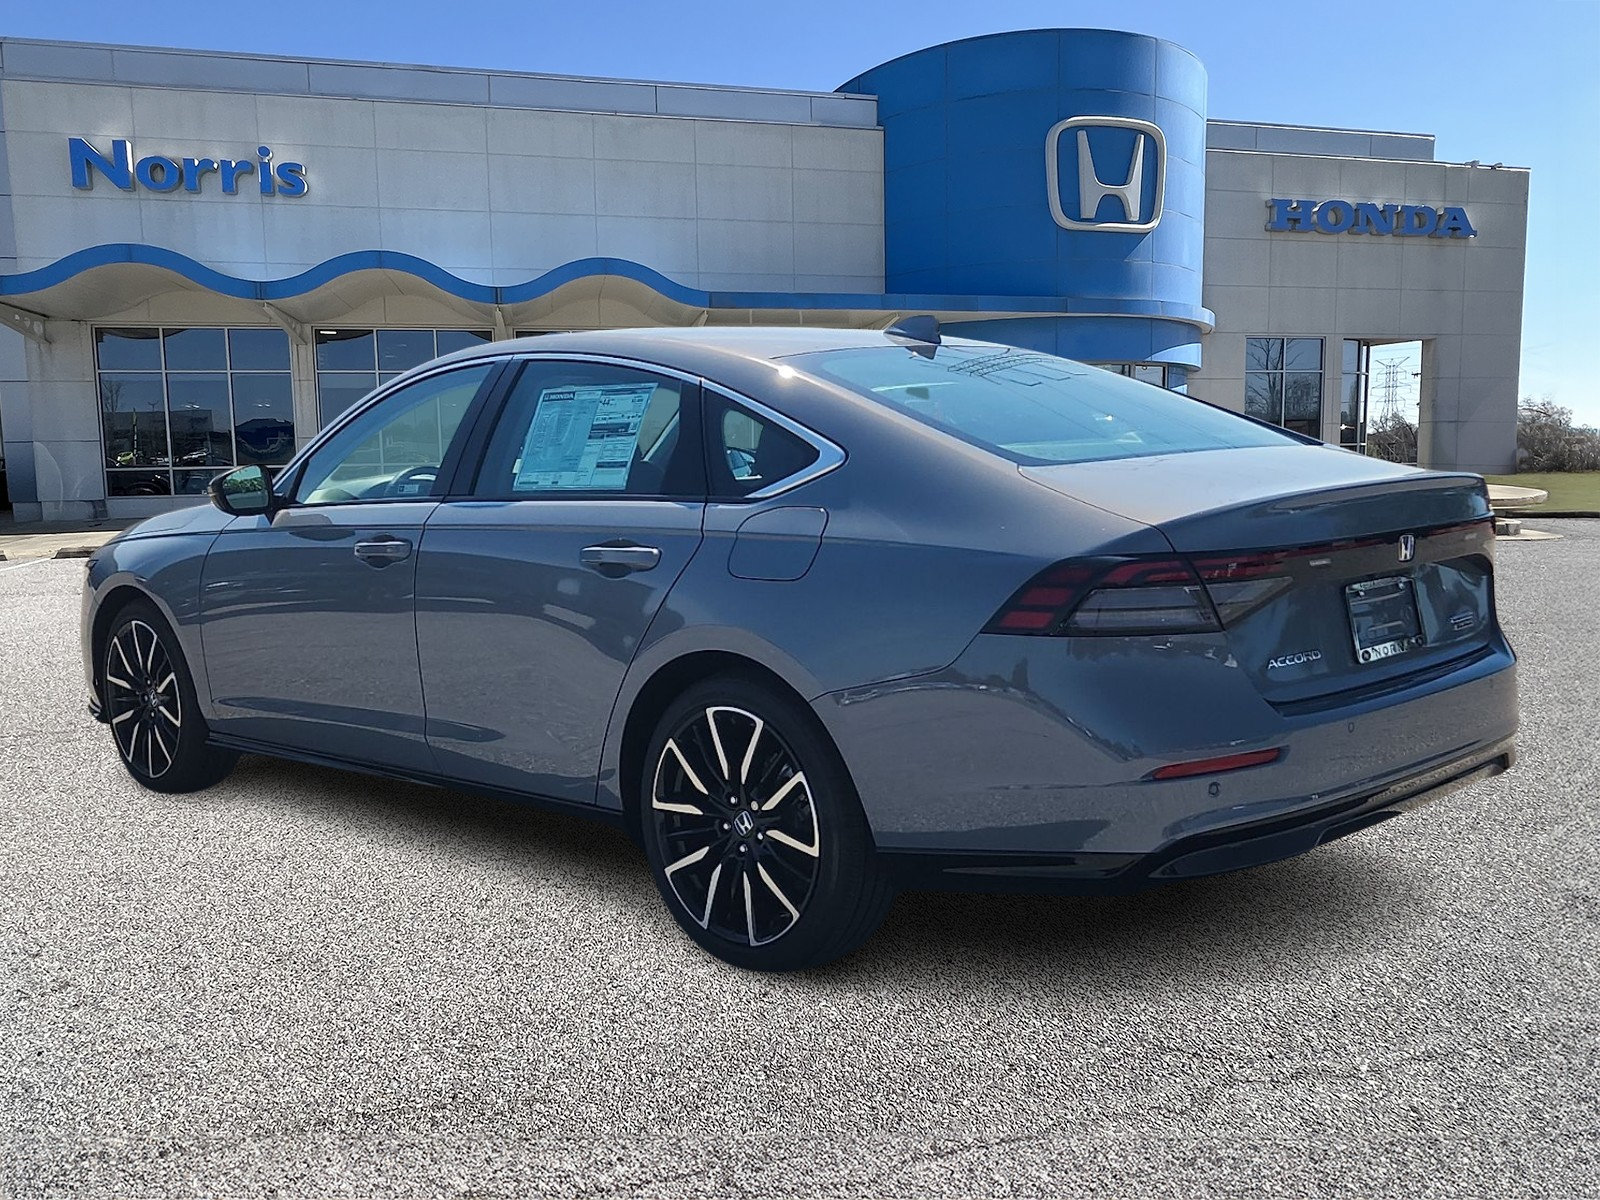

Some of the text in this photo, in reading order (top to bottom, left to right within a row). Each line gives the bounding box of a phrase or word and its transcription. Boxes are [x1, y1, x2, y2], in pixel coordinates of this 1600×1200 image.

[68, 137, 308, 197] Norris
[1265, 198, 1477, 239] HONDA
[550, 392, 574, 400] HONDA
[1267, 650, 1321, 670] ACCORD
